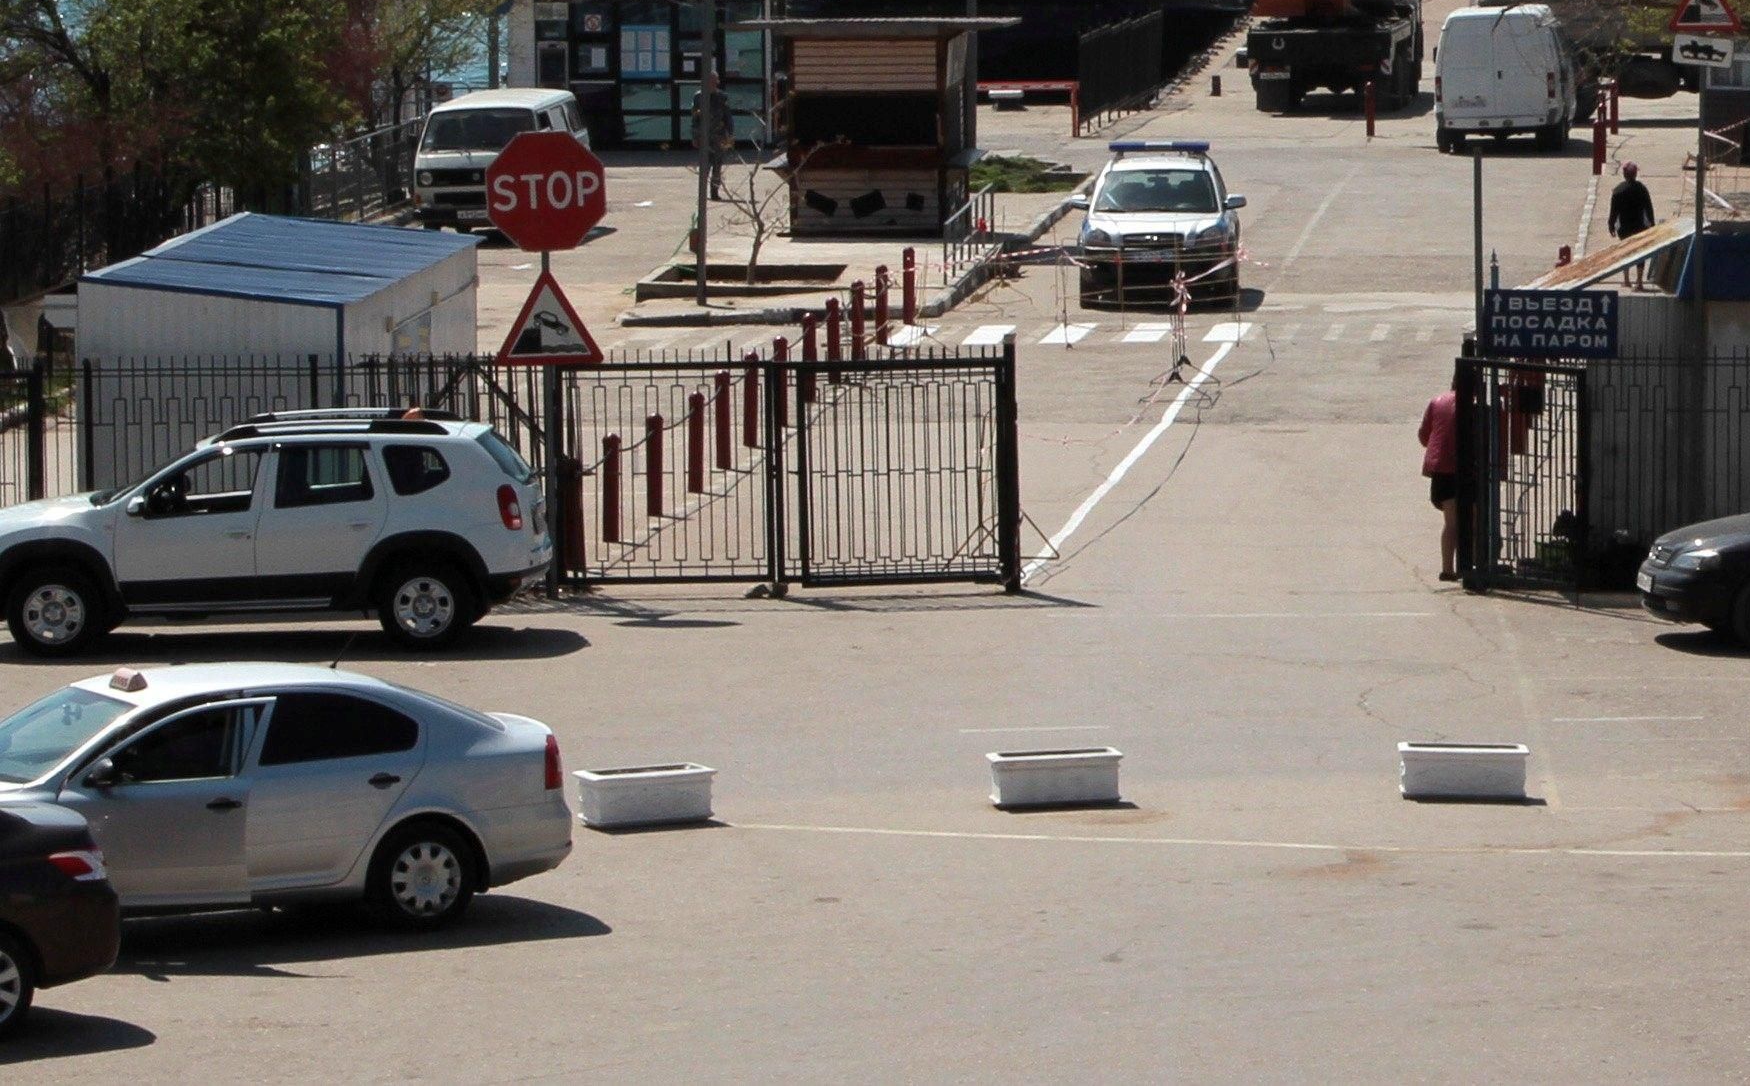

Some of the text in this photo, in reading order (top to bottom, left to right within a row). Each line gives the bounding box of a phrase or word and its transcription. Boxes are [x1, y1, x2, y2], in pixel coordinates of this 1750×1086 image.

[493, 170, 600, 212] STOP
[1508, 296, 1593, 314] ВЪЕЗД
[1491, 315, 1608, 332] ПОСАДКА
[1493, 334, 1608, 348] НА ПАРОМ
